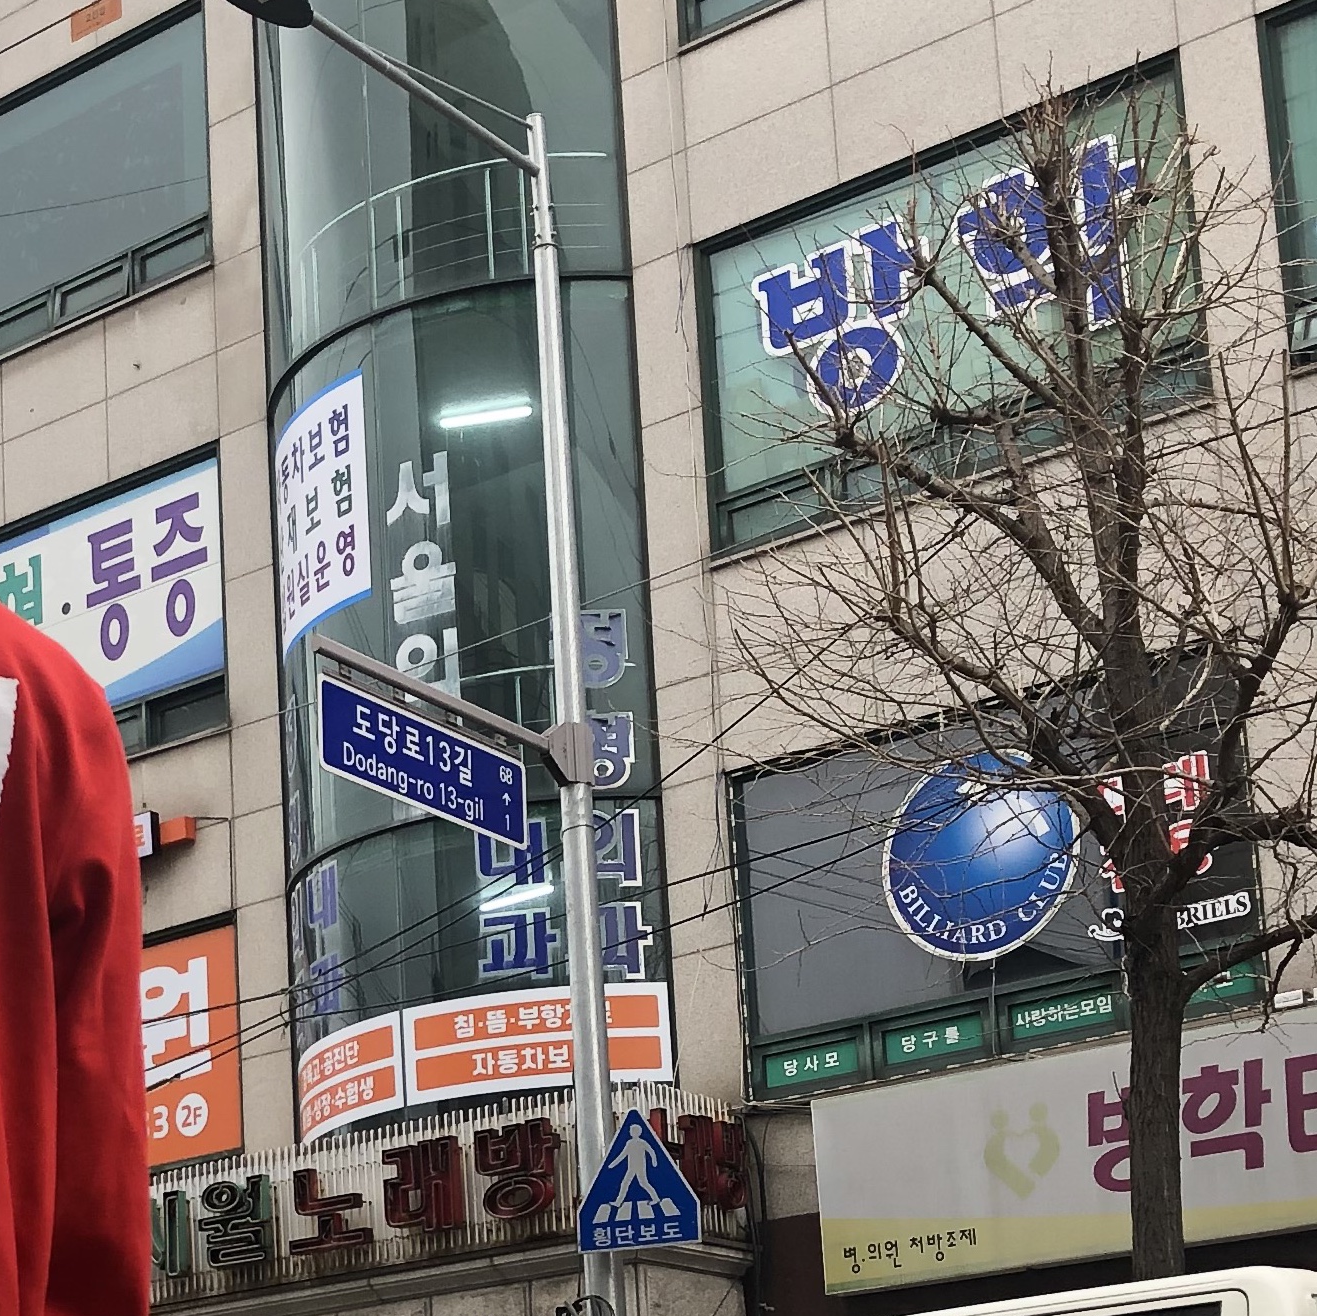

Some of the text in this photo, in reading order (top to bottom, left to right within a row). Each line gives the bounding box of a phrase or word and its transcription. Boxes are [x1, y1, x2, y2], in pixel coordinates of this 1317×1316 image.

[353, 705, 473, 787] 도당로13길
[343, 742, 484, 821] Dodang-ro 13-gil
[499, 766, 513, 785] 68
[505, 814, 510, 831] 1
[1017, 851, 1068, 922] CLUB
[898, 884, 1007, 944] BILLIARD
[454, 1001, 613, 1039] 침·뜸·부항
[901, 1025, 960, 1053] 당구를
[472, 1045, 571, 1076] 자동차보
[783, 1051, 841, 1077] 당사모
[145, 1105, 169, 1139] 3
[181, 1104, 203, 1128] 2F
[592, 1222, 683, 1247] 횡단보도
[909, 1228, 977, 1261] 처방조제
